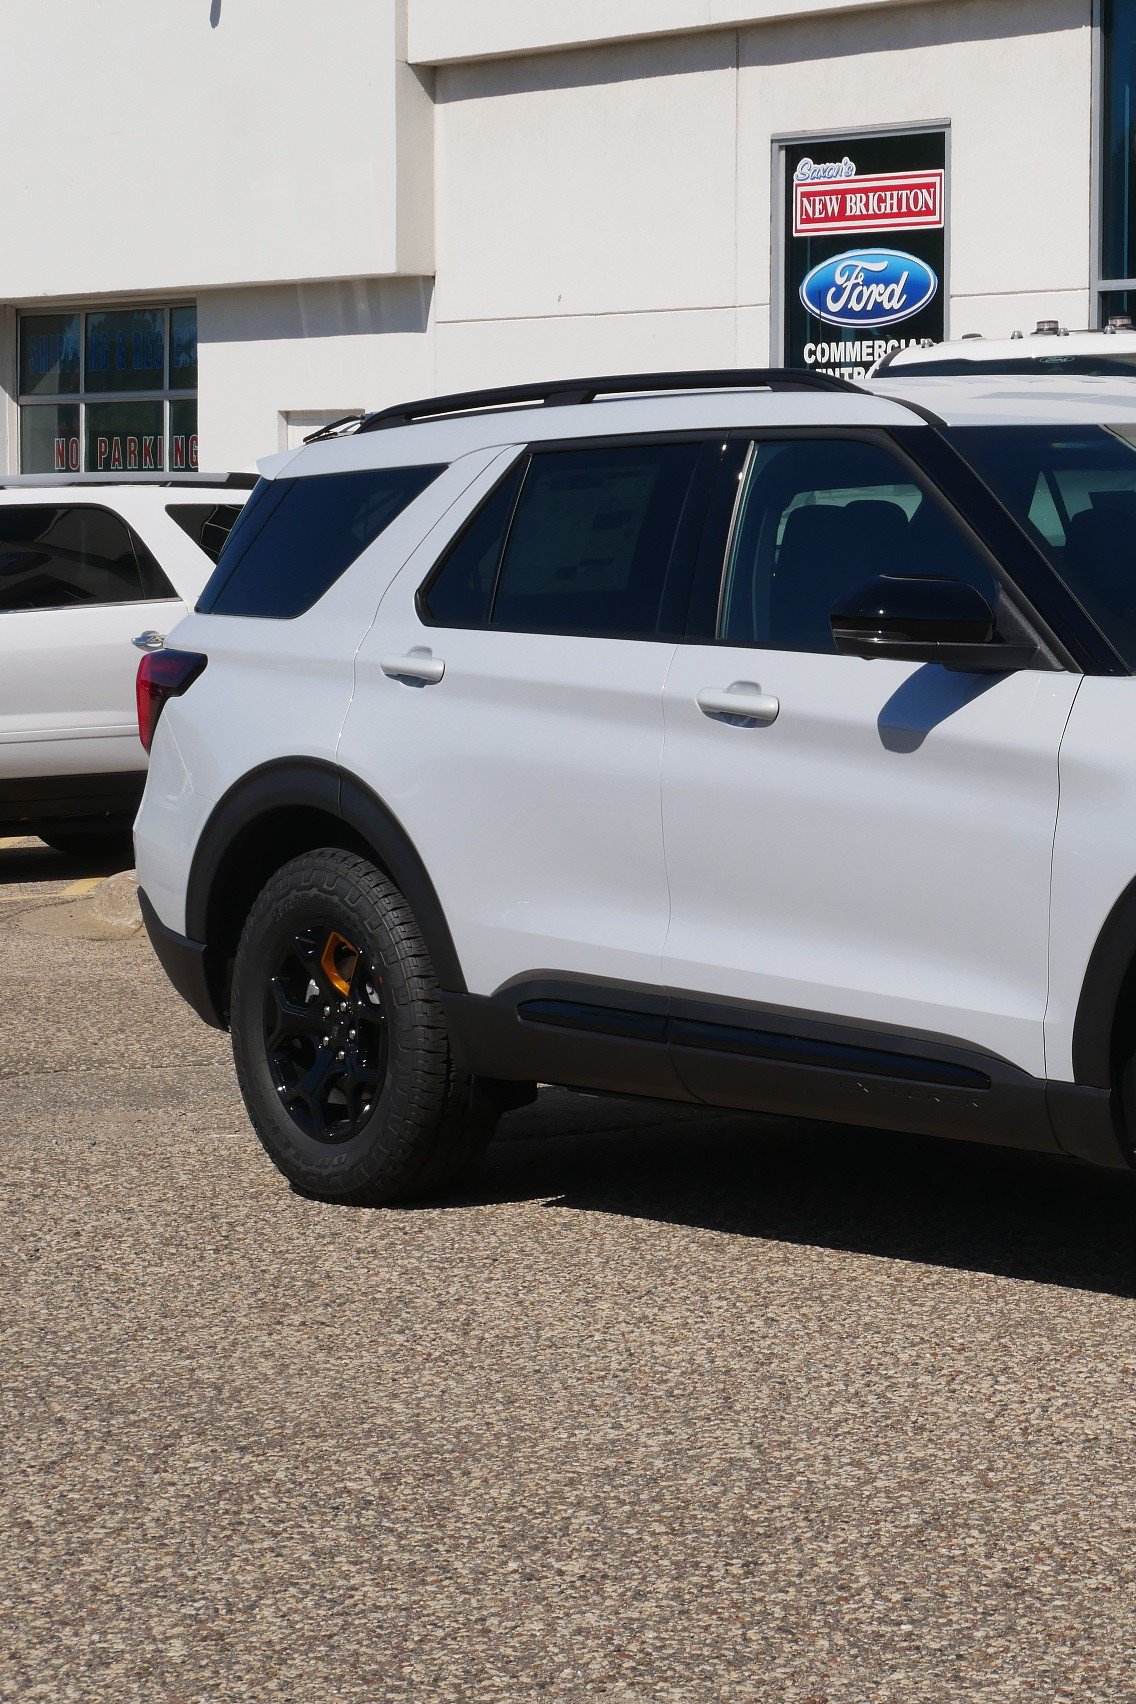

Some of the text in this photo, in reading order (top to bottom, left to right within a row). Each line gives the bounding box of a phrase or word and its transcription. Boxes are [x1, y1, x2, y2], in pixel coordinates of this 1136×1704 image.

[796, 156, 855, 182] Saxon's
[801, 188, 935, 219] NEW BRIGHTON
[826, 260, 910, 313] Ford
[54, 435, 198, 470] NO PARKING
